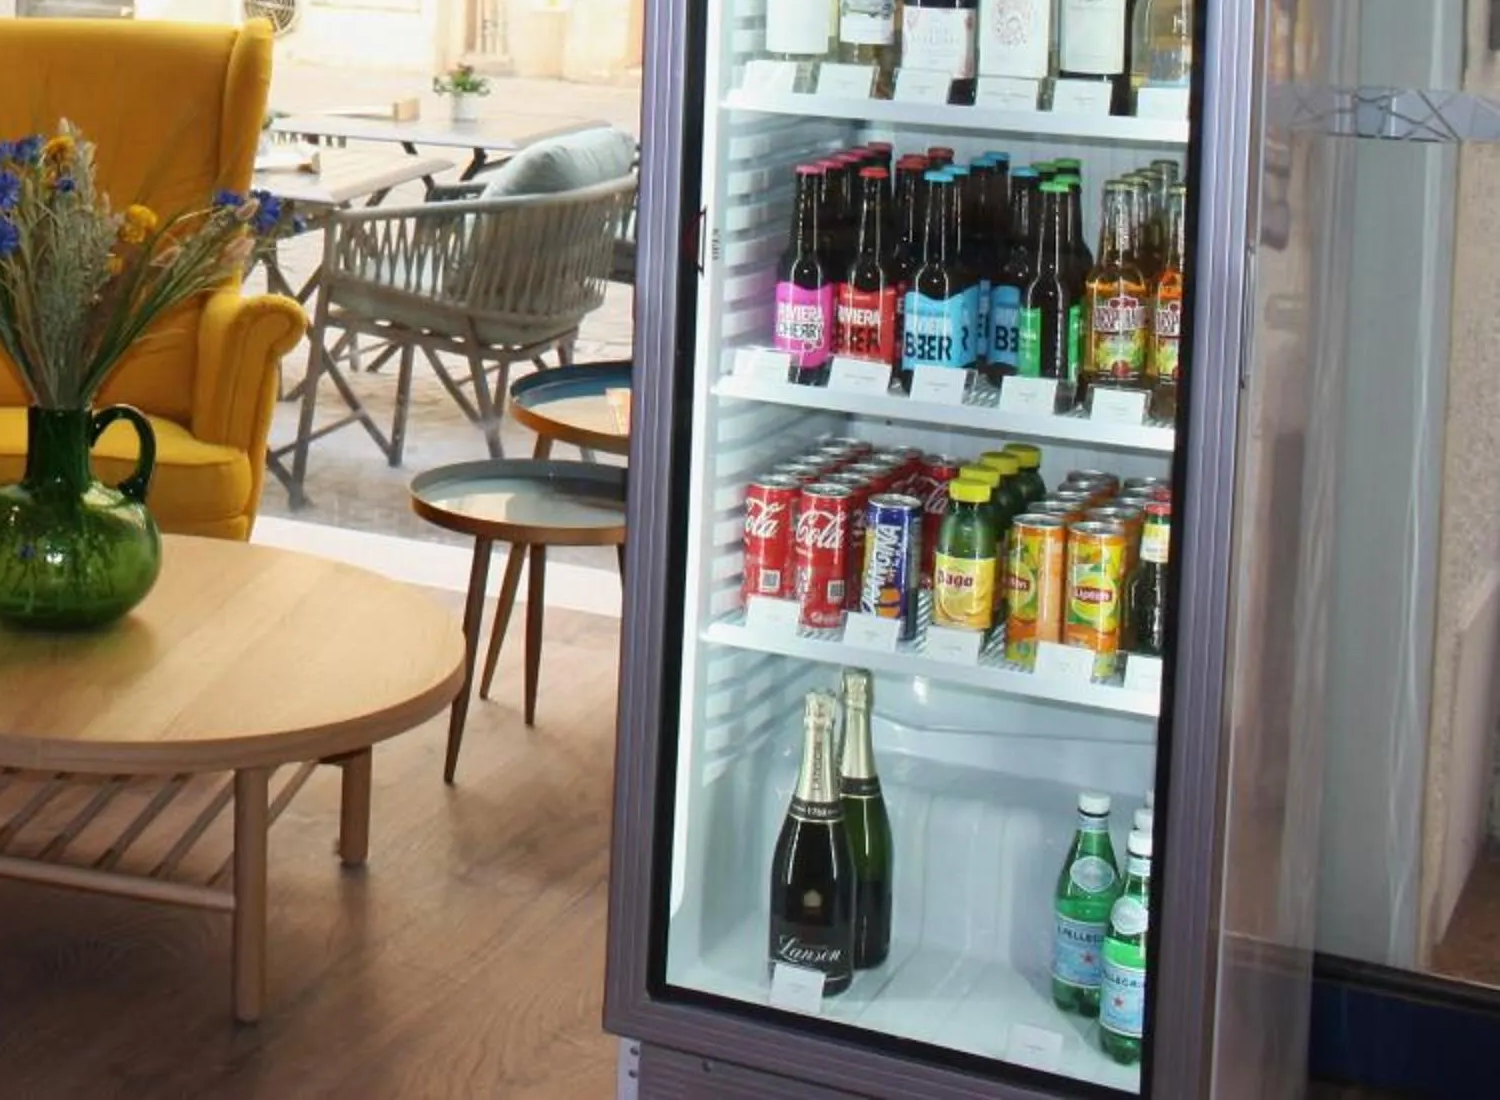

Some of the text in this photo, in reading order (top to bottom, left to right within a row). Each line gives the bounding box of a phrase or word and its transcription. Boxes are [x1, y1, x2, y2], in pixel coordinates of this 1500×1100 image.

[936, 568, 973, 588] pago
[1075, 585, 1112, 601] Lipton
[779, 935, 842, 963] Lanson
